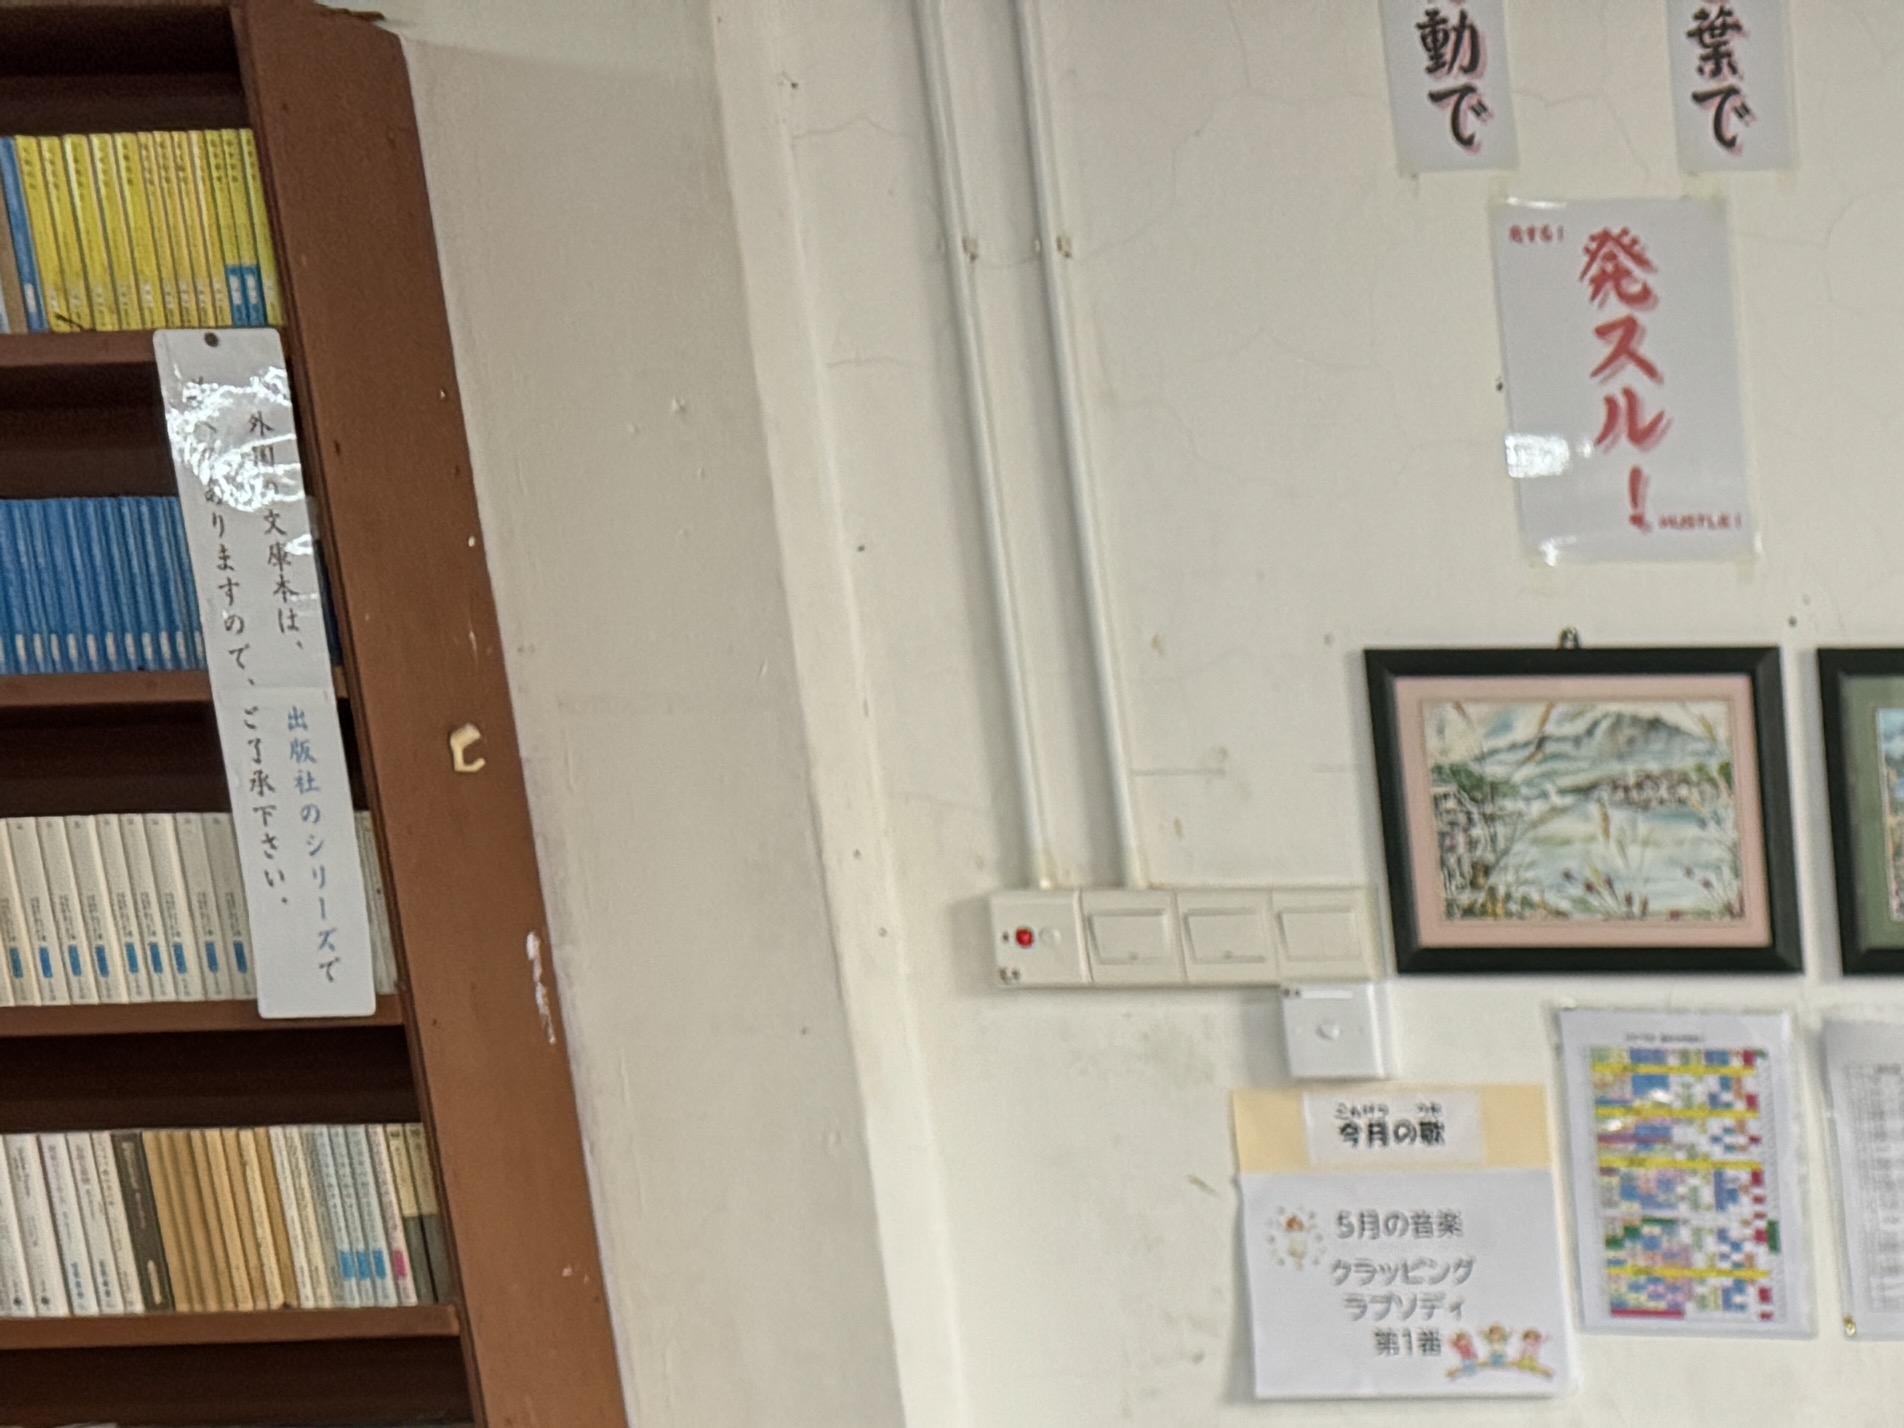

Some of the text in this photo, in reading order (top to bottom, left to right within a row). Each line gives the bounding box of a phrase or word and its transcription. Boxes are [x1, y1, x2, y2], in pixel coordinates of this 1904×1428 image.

[1339, 1119, 1445, 1147] 今月の歌
[1336, 1210, 1464, 1239] 5月の音楽
[1331, 1257, 1476, 1286] クラッピング
[1343, 1294, 1464, 1321] ラプソディ
[1374, 1328, 1444, 1356] 第1番
